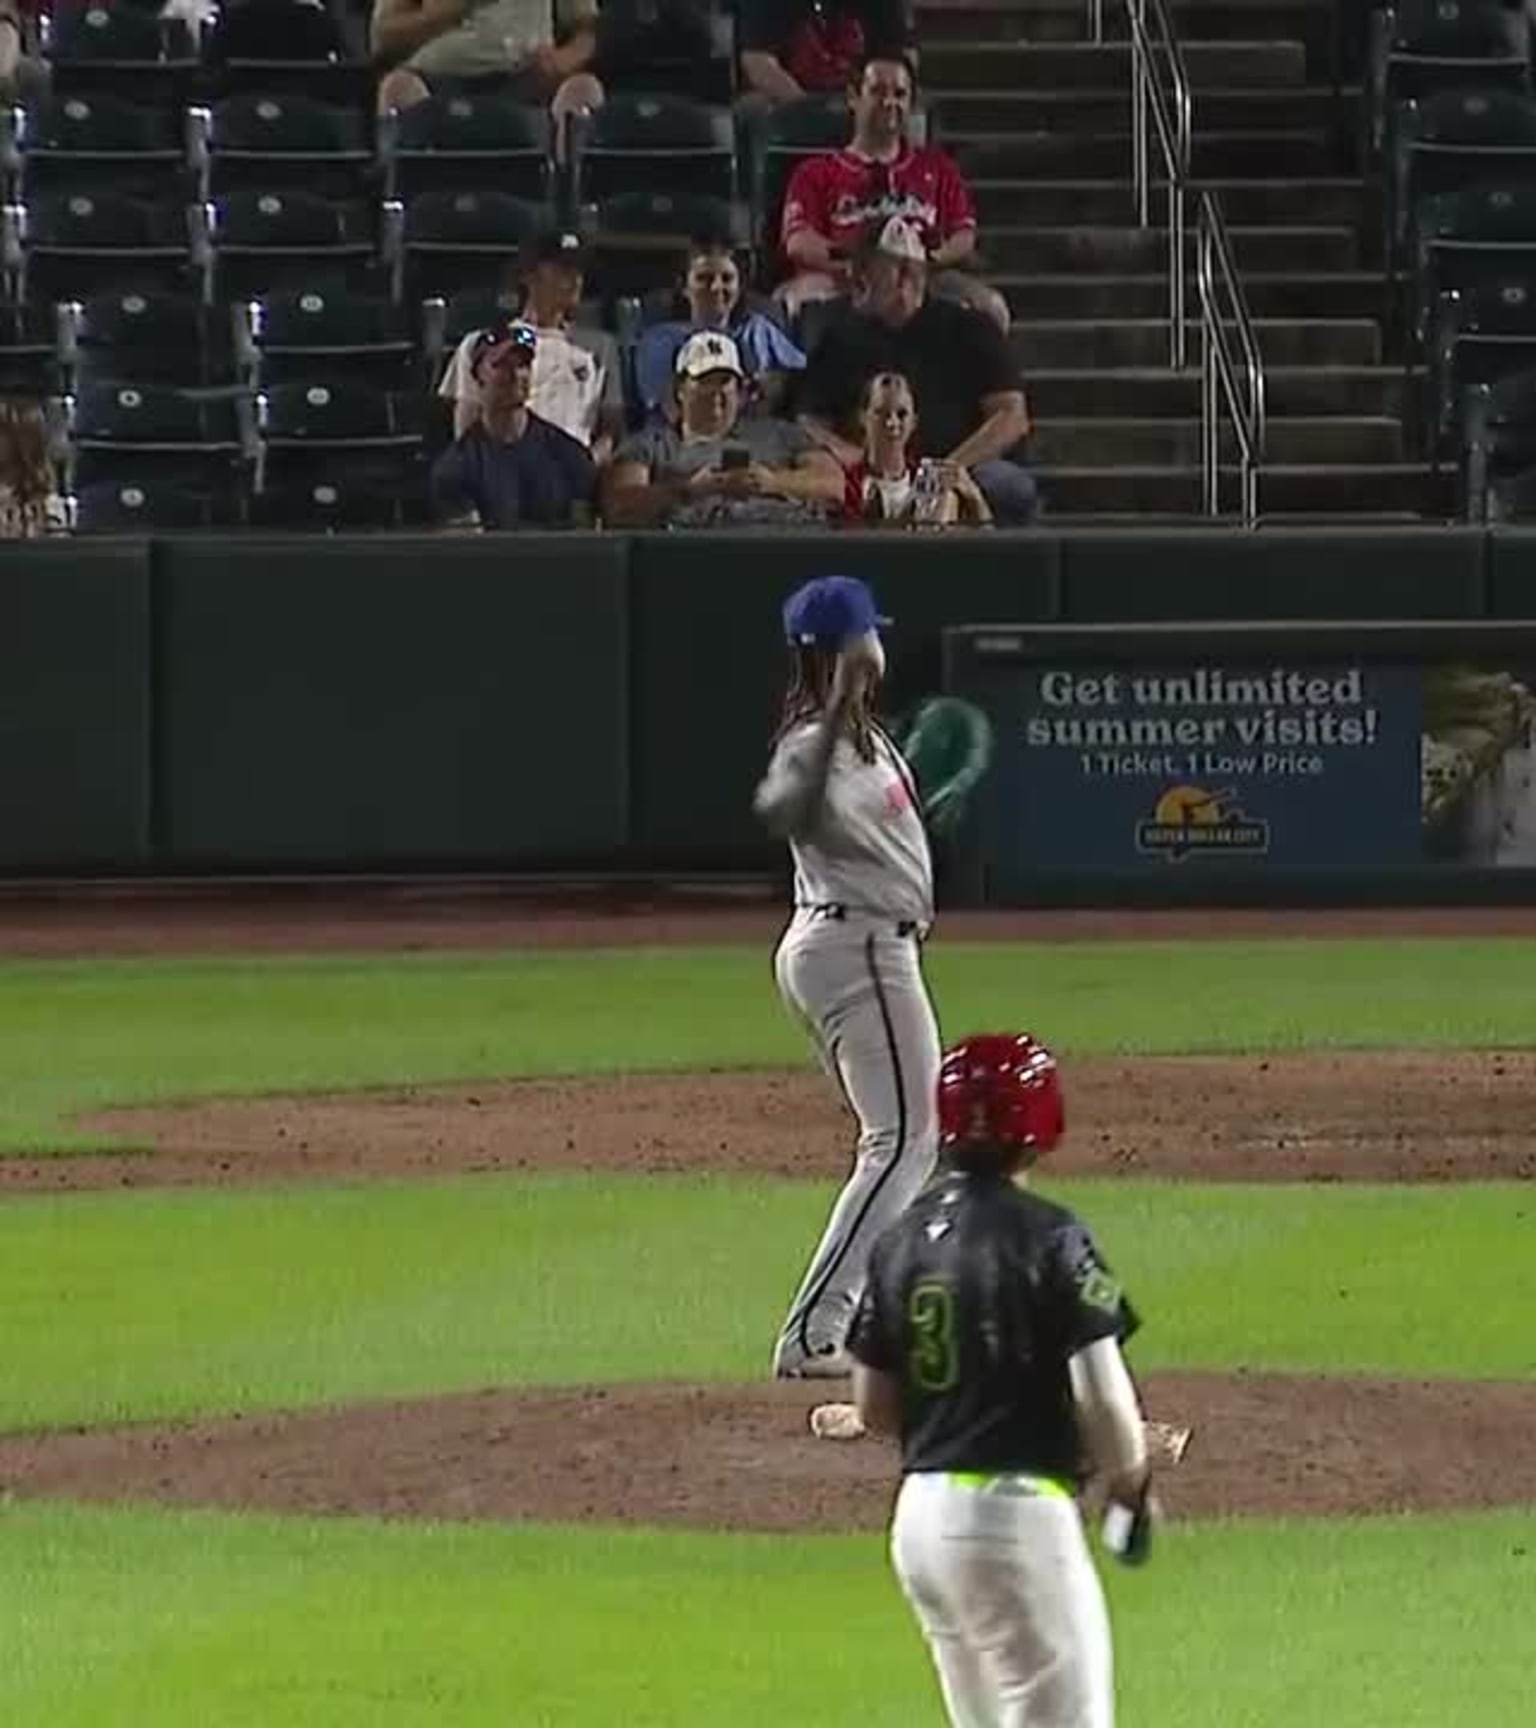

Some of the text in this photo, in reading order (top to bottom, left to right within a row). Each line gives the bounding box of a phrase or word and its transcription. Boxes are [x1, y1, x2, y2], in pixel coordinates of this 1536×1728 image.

[1040, 669, 1363, 706] Get unlimited
[1026, 709, 1378, 747] summer visits!
[1080, 754, 1091, 775] 1
[1187, 753, 1198, 775] 1
[1204, 752, 1257, 775] Low
[1263, 751, 1324, 775] Price
[908, 1275, 958, 1392] 3
